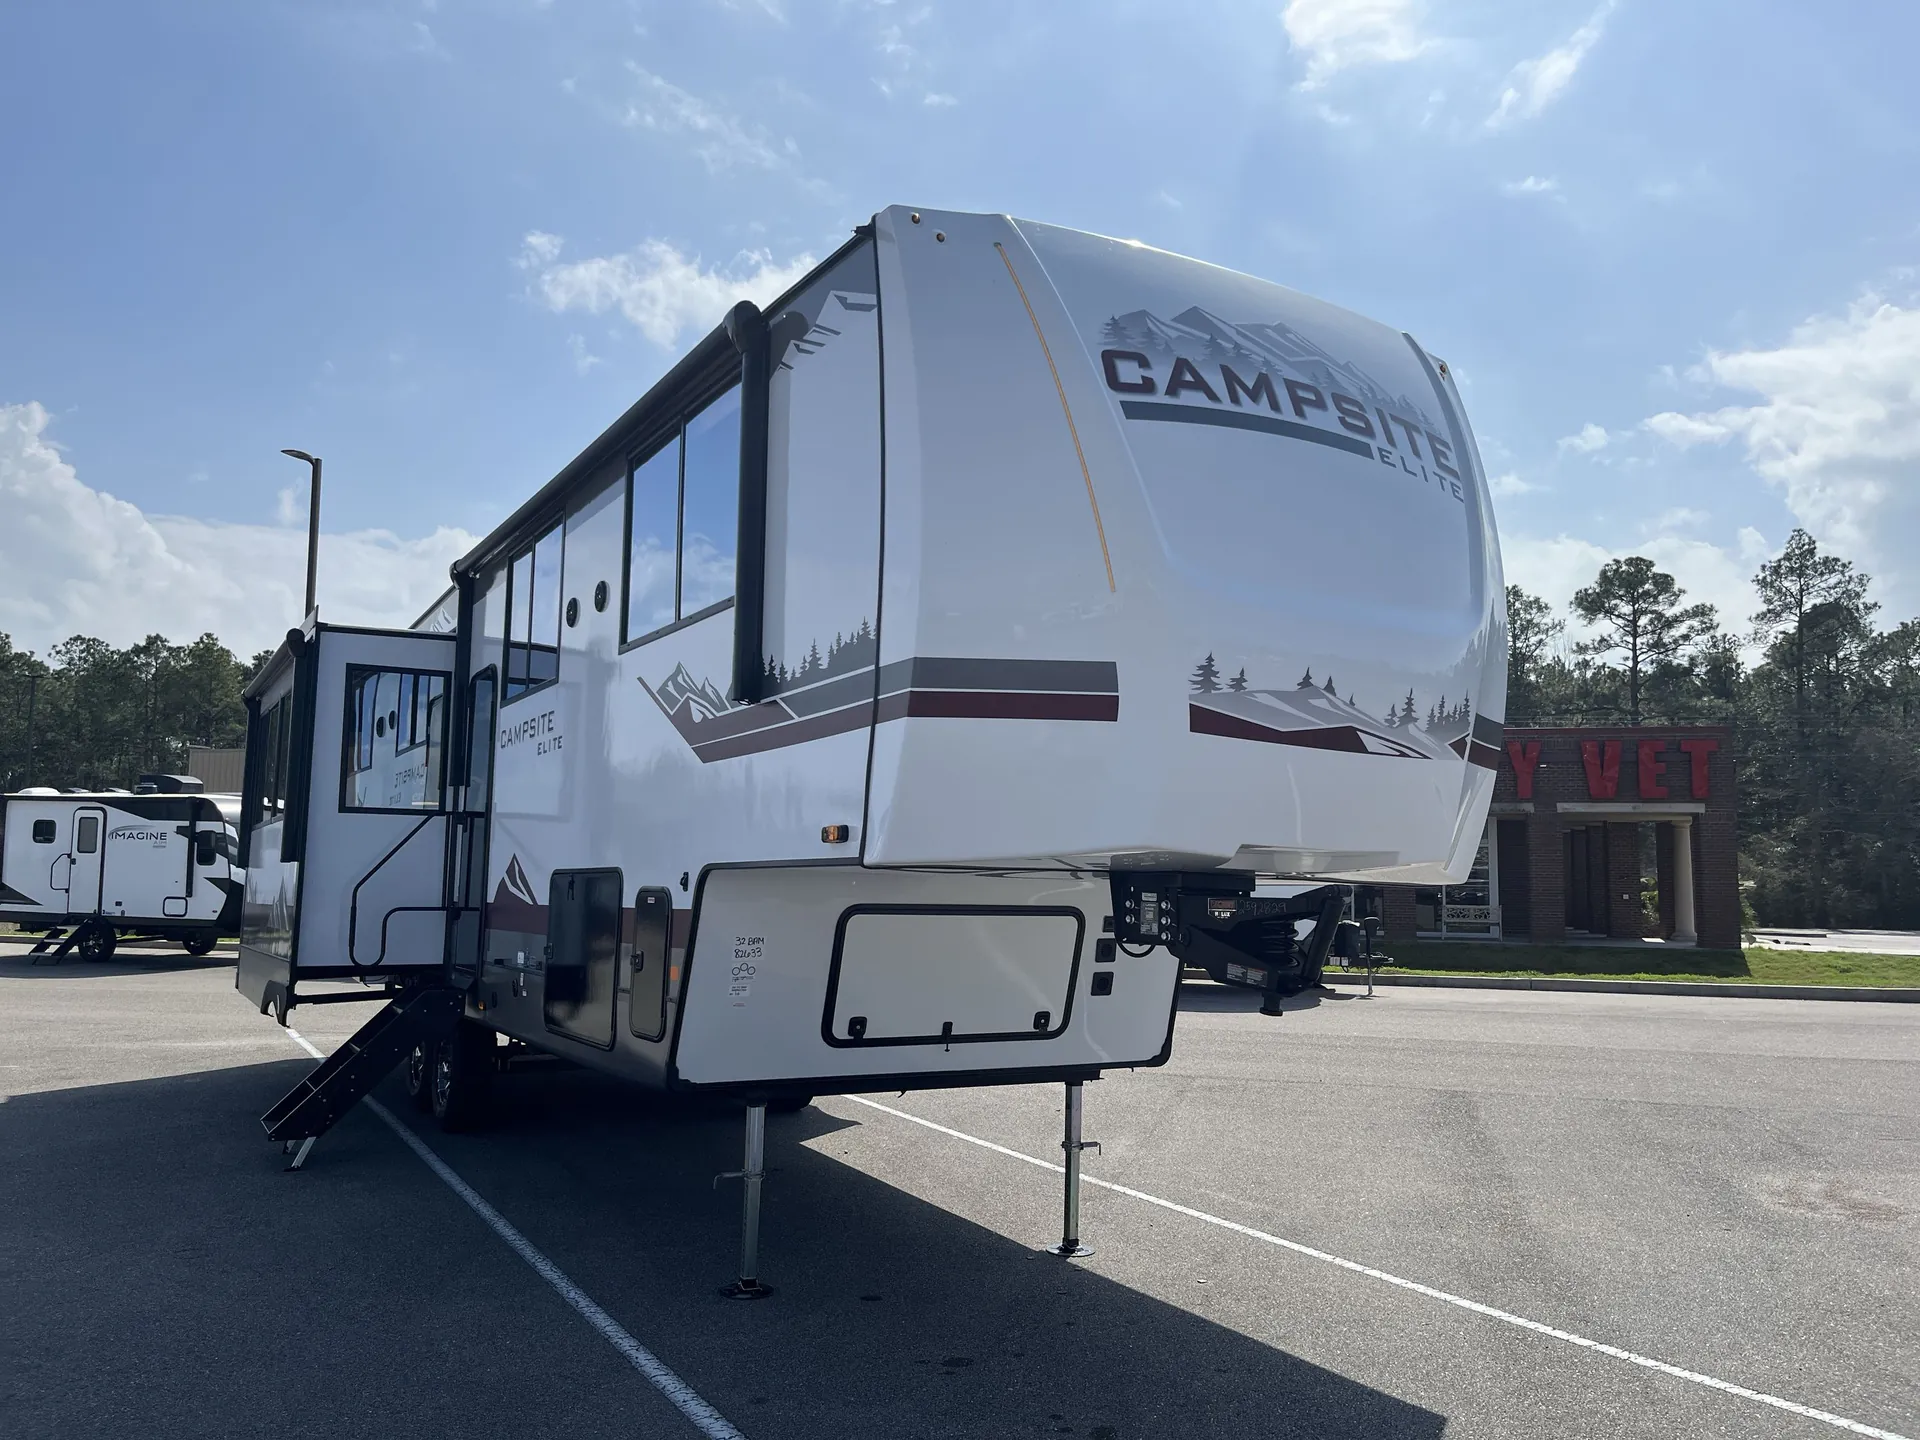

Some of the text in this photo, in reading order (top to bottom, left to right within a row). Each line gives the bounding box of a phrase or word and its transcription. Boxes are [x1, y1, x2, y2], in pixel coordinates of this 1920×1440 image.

[1101, 349, 1461, 482] CAMPSITE
[1377, 446, 1464, 503] ELITE
[501, 710, 555, 749] CAMPSITE
[537, 736, 563, 756] ELITE
[1581, 739, 1719, 799] VET
[111, 831, 168, 841] IMAGINE
[735, 936, 746, 946] 32
